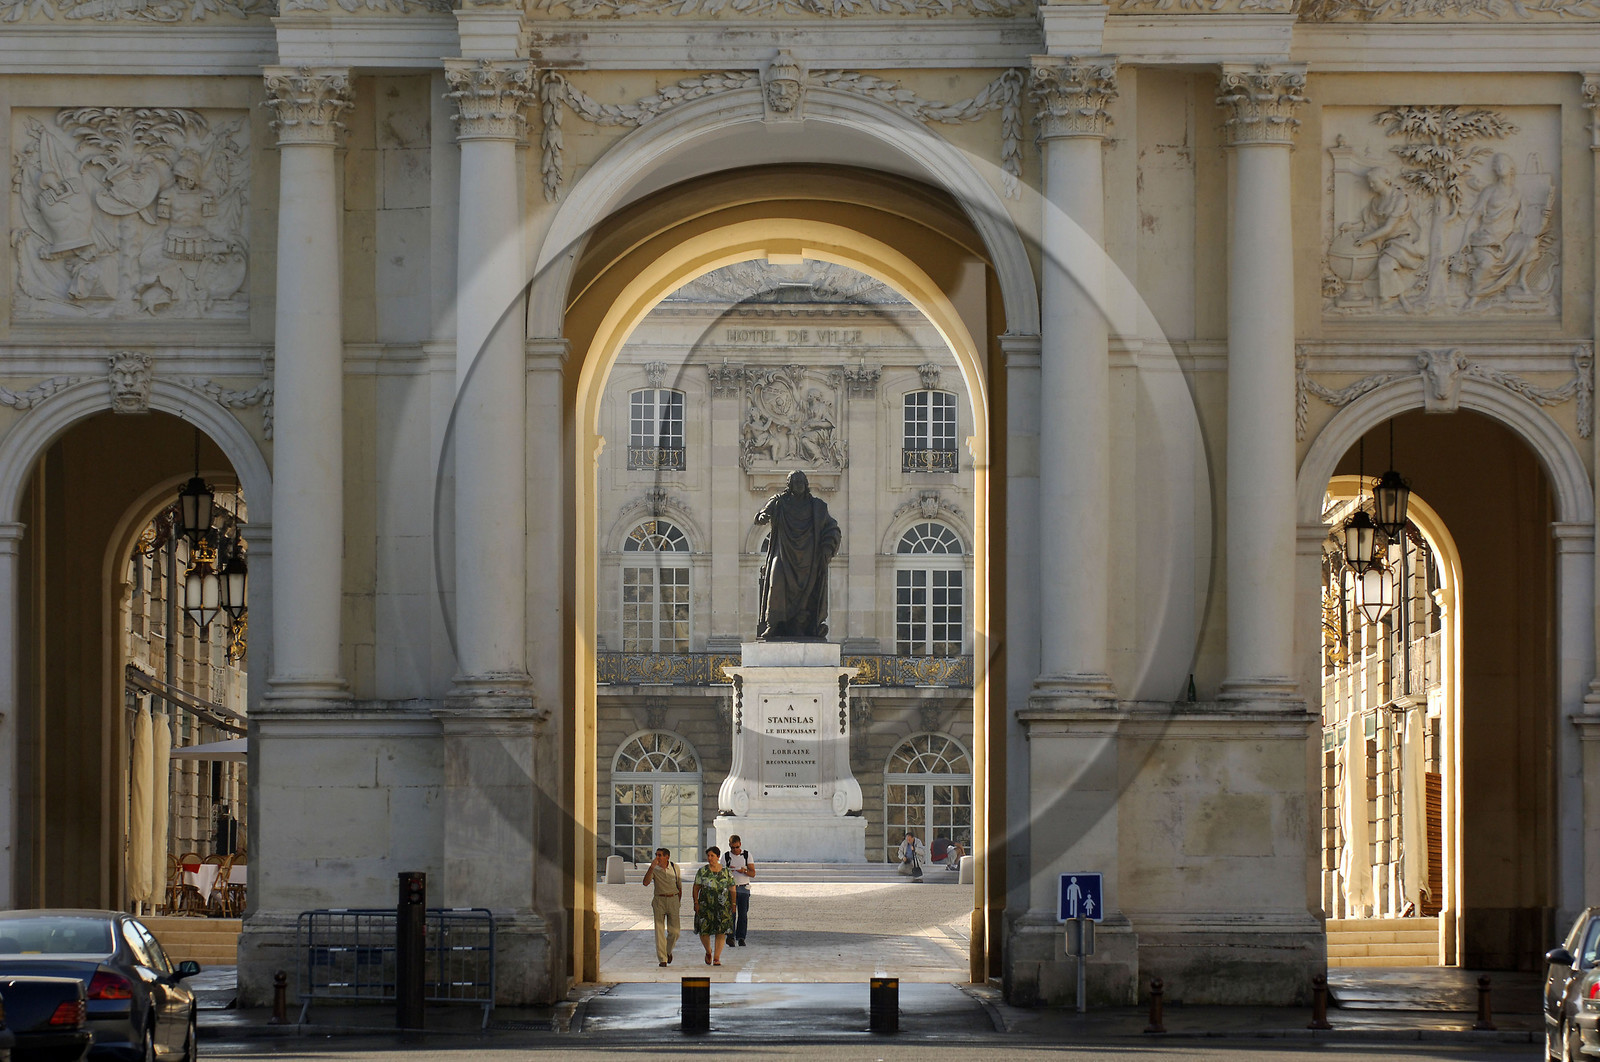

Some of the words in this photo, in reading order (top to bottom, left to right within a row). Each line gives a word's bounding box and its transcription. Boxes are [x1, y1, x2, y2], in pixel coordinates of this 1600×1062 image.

[787, 329, 809, 342] DE
[816, 329, 863, 342] VILLE
[767, 716, 814, 724] STANISLAS
